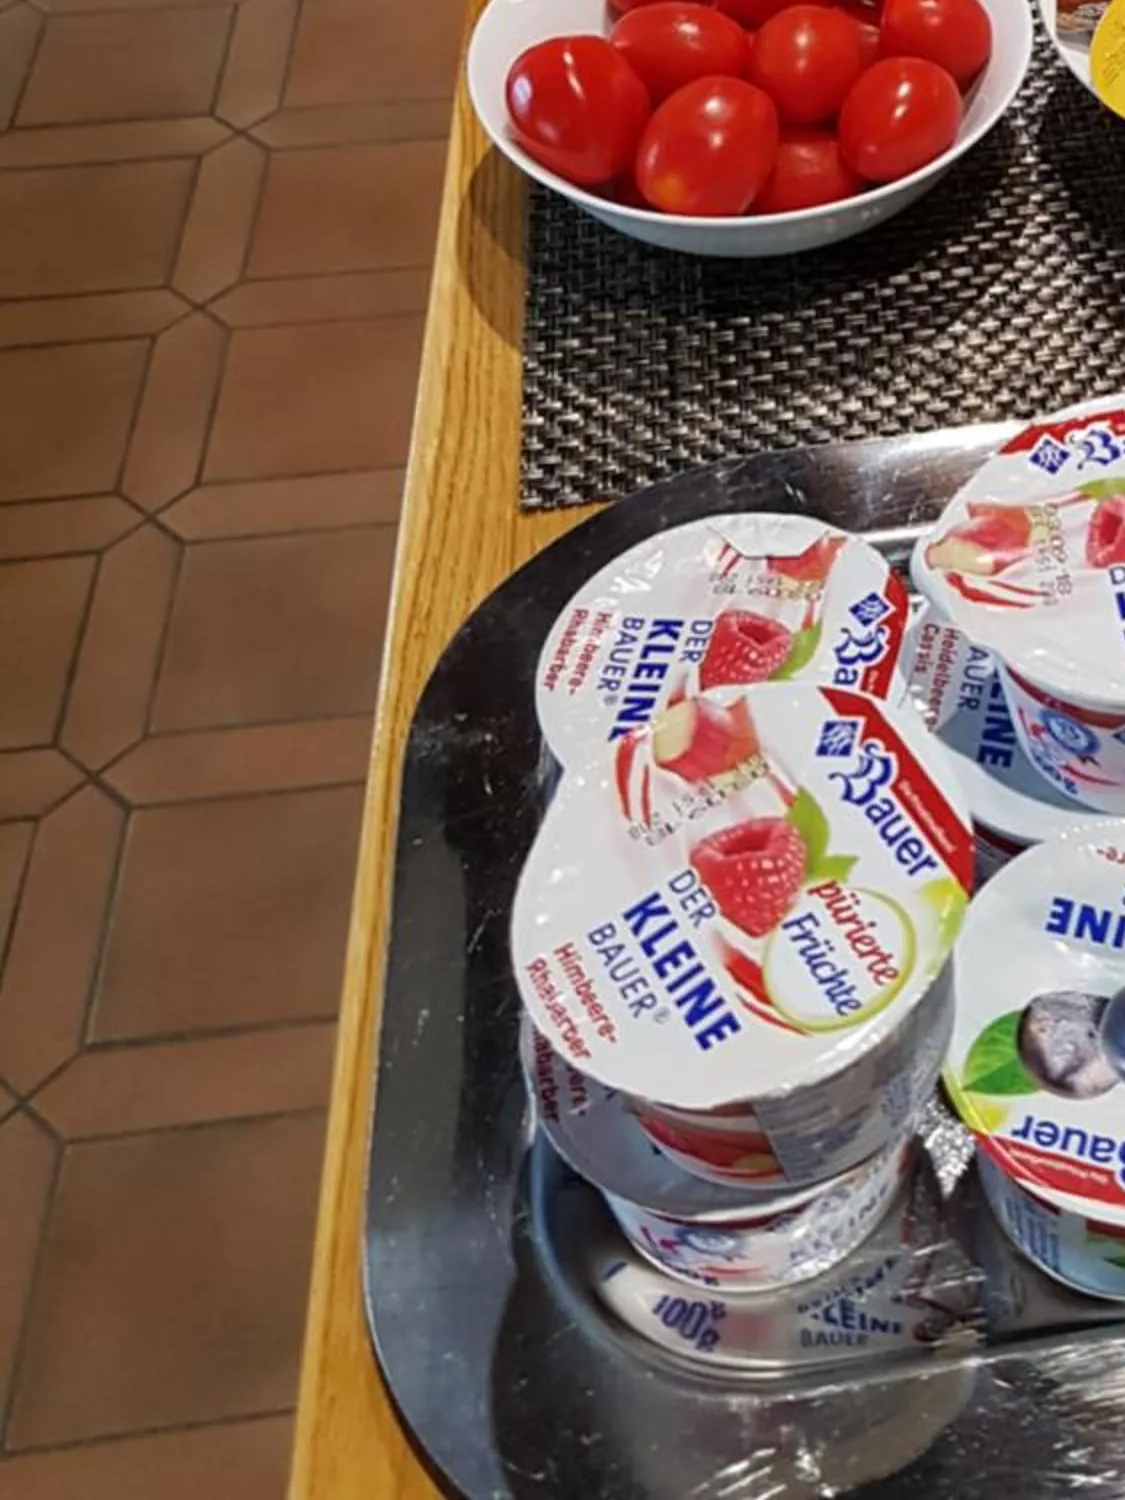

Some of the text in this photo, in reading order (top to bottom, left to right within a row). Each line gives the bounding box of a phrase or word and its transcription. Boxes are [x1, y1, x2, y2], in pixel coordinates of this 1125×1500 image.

[596, 616, 646, 692] BAUER
[679, 619, 713, 665] DER
[957, 645, 990, 711] AUER
[831, 746, 938, 878] Bauer
[668, 869, 717, 927] DER
[808, 879, 899, 988] pürierte
[553, 944, 619, 1045] Himbeere-
[587, 924, 658, 1020] BAUER
[623, 890, 742, 1051] KLEINE
[781, 913, 862, 1018] Früchte
